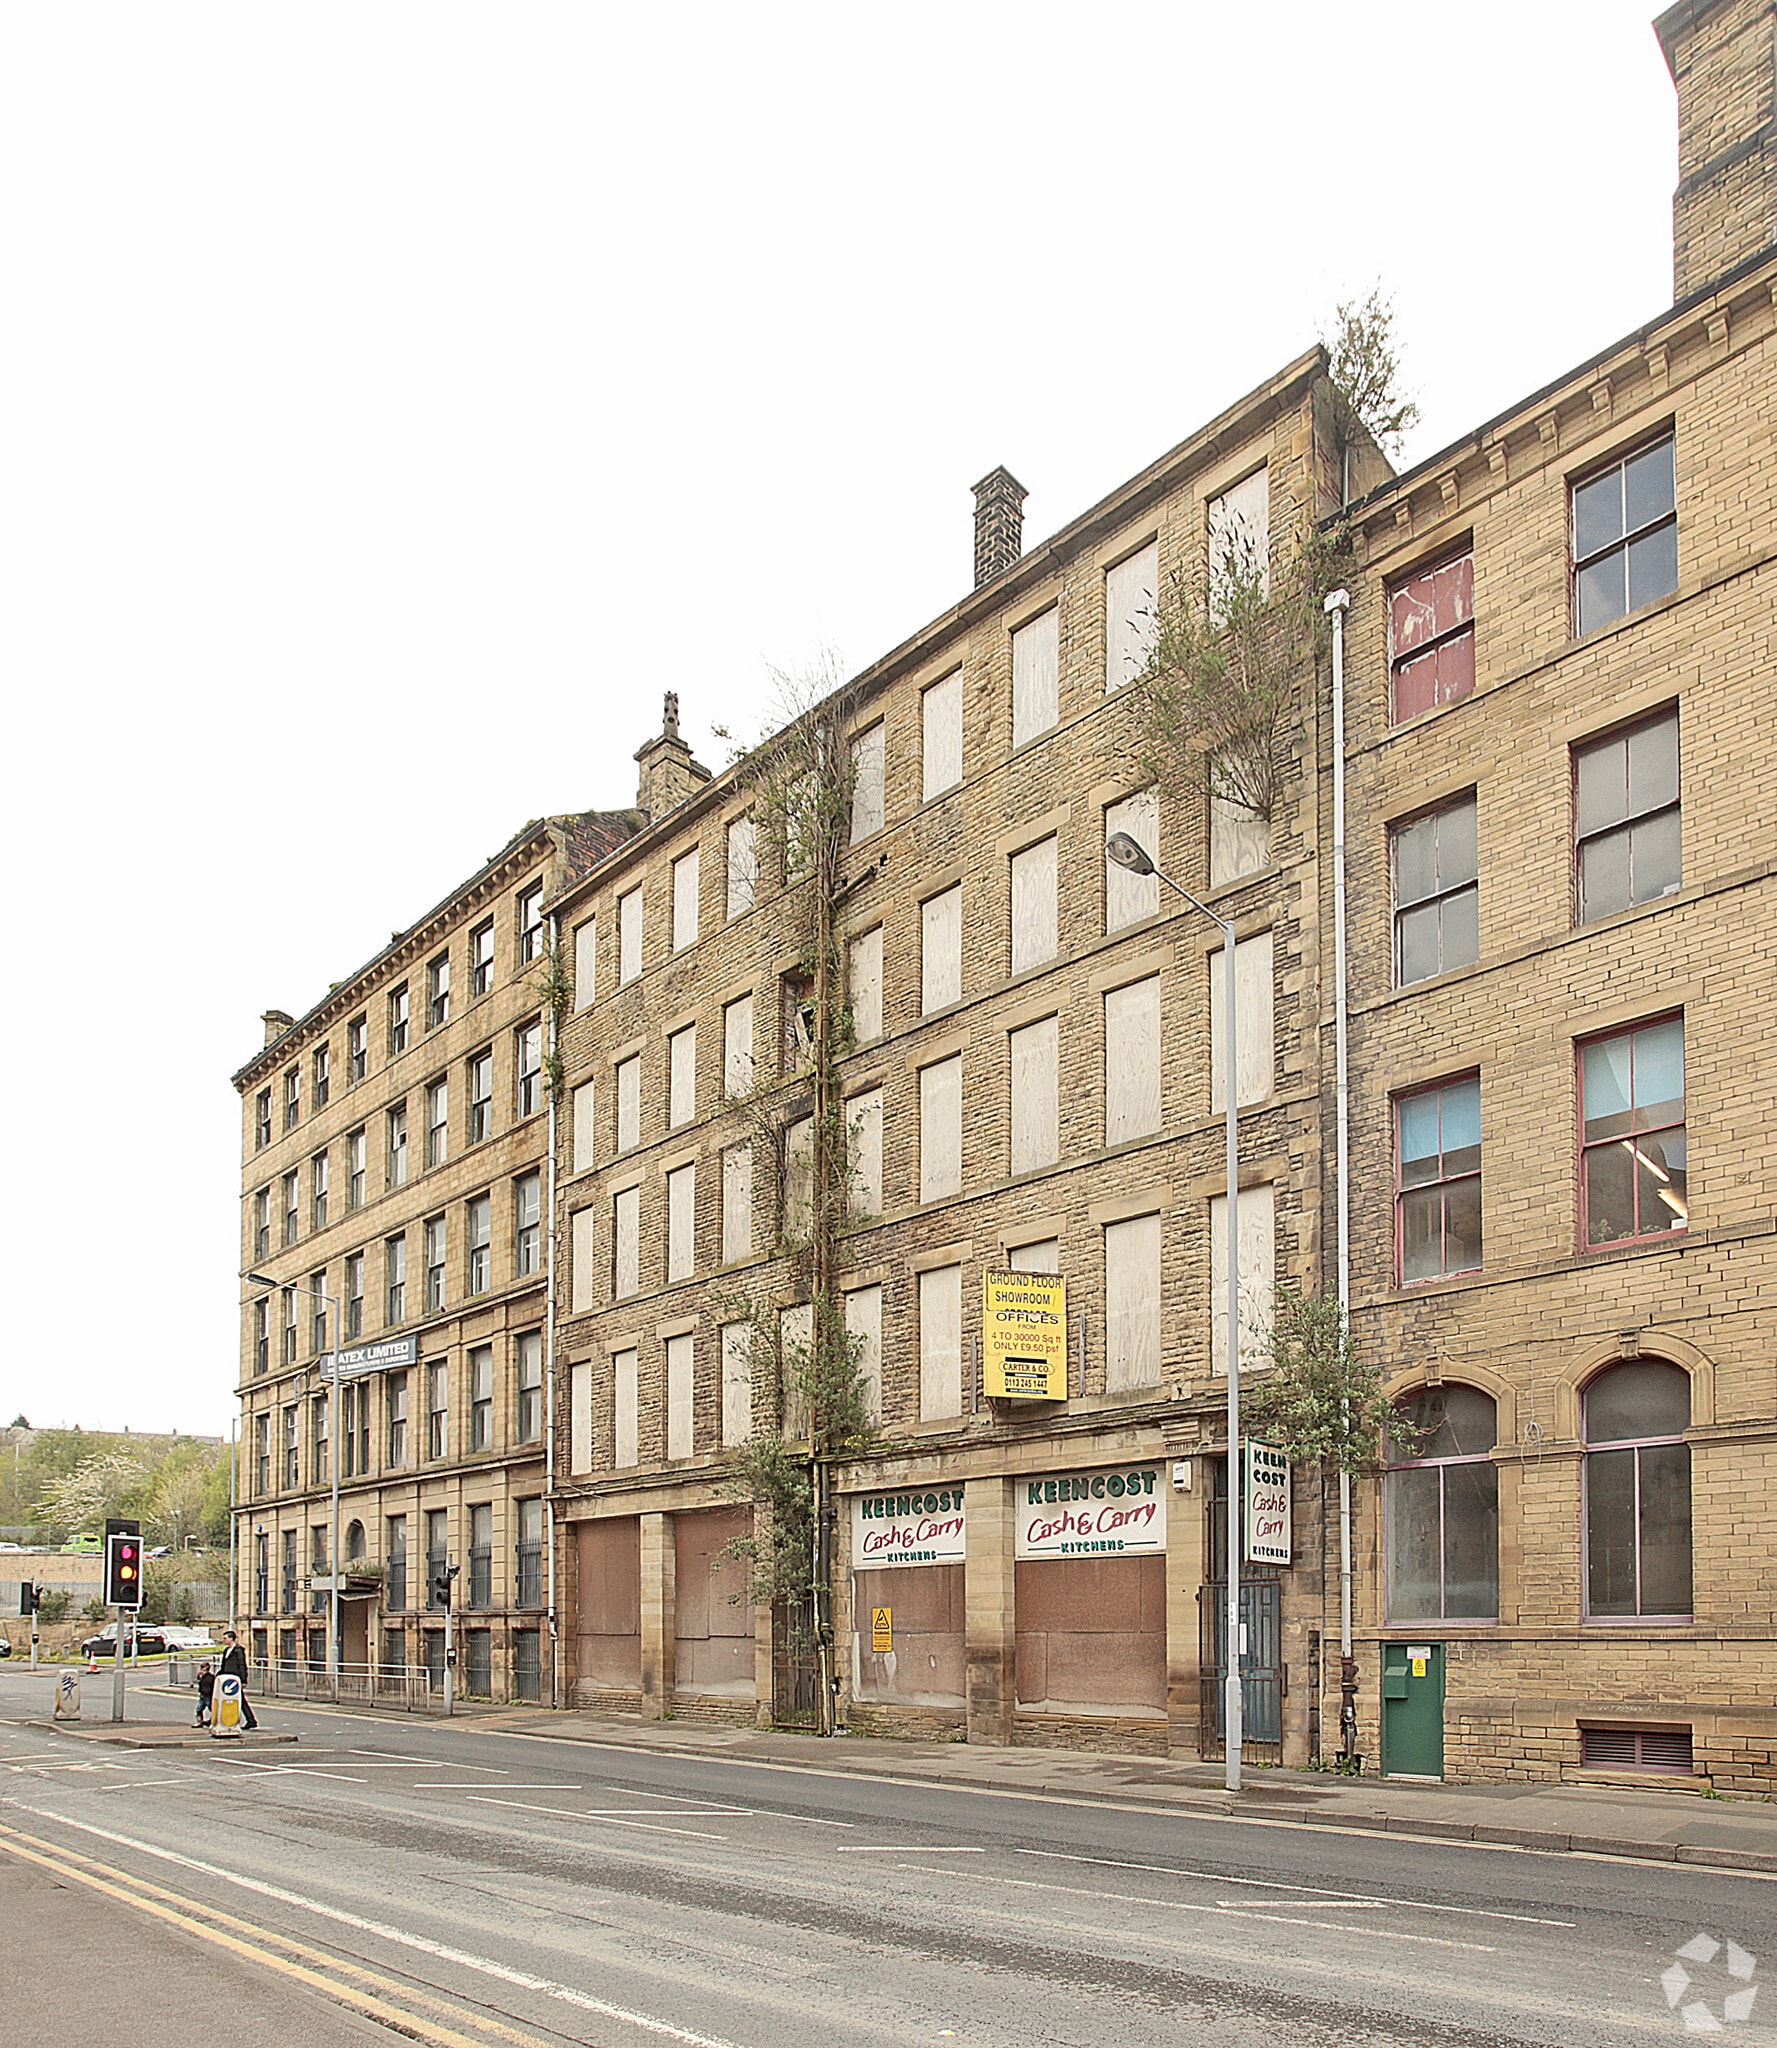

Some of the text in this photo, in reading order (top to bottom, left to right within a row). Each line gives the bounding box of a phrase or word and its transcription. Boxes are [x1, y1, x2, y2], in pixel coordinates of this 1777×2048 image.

[990, 1273, 1061, 1289] GROUND FLOOR
[995, 1291, 1050, 1305] SHOWROOM
[999, 1332, 1012, 1340] TO
[1014, 1333, 1040, 1342] 30000
[1042, 1334, 1053, 1344] Sq
[367, 1341, 409, 1359] LIMITED
[994, 1341, 1059, 1353] ONLY £9.50 psf
[1002, 1363, 1030, 1372] CARTER
[1005, 1378, 1019, 1387] 0113
[1253, 1449, 1286, 1469] KEEN
[1253, 1469, 1286, 1487] COST
[1028, 1471, 1157, 1505] KEENCOST
[862, 1490, 964, 1519] KEENCOST
[1253, 1491, 1277, 1512] Cash
[1027, 1502, 1156, 1543] Cash & Carry
[1256, 1516, 1284, 1538] Carry
[863, 1517, 964, 1553] Cash & Carry
[1061, 1540, 1125, 1553] KITCHENS
[1253, 1545, 1288, 1559] KITCHENS
[887, 1550, 937, 1562] KITCHENS
